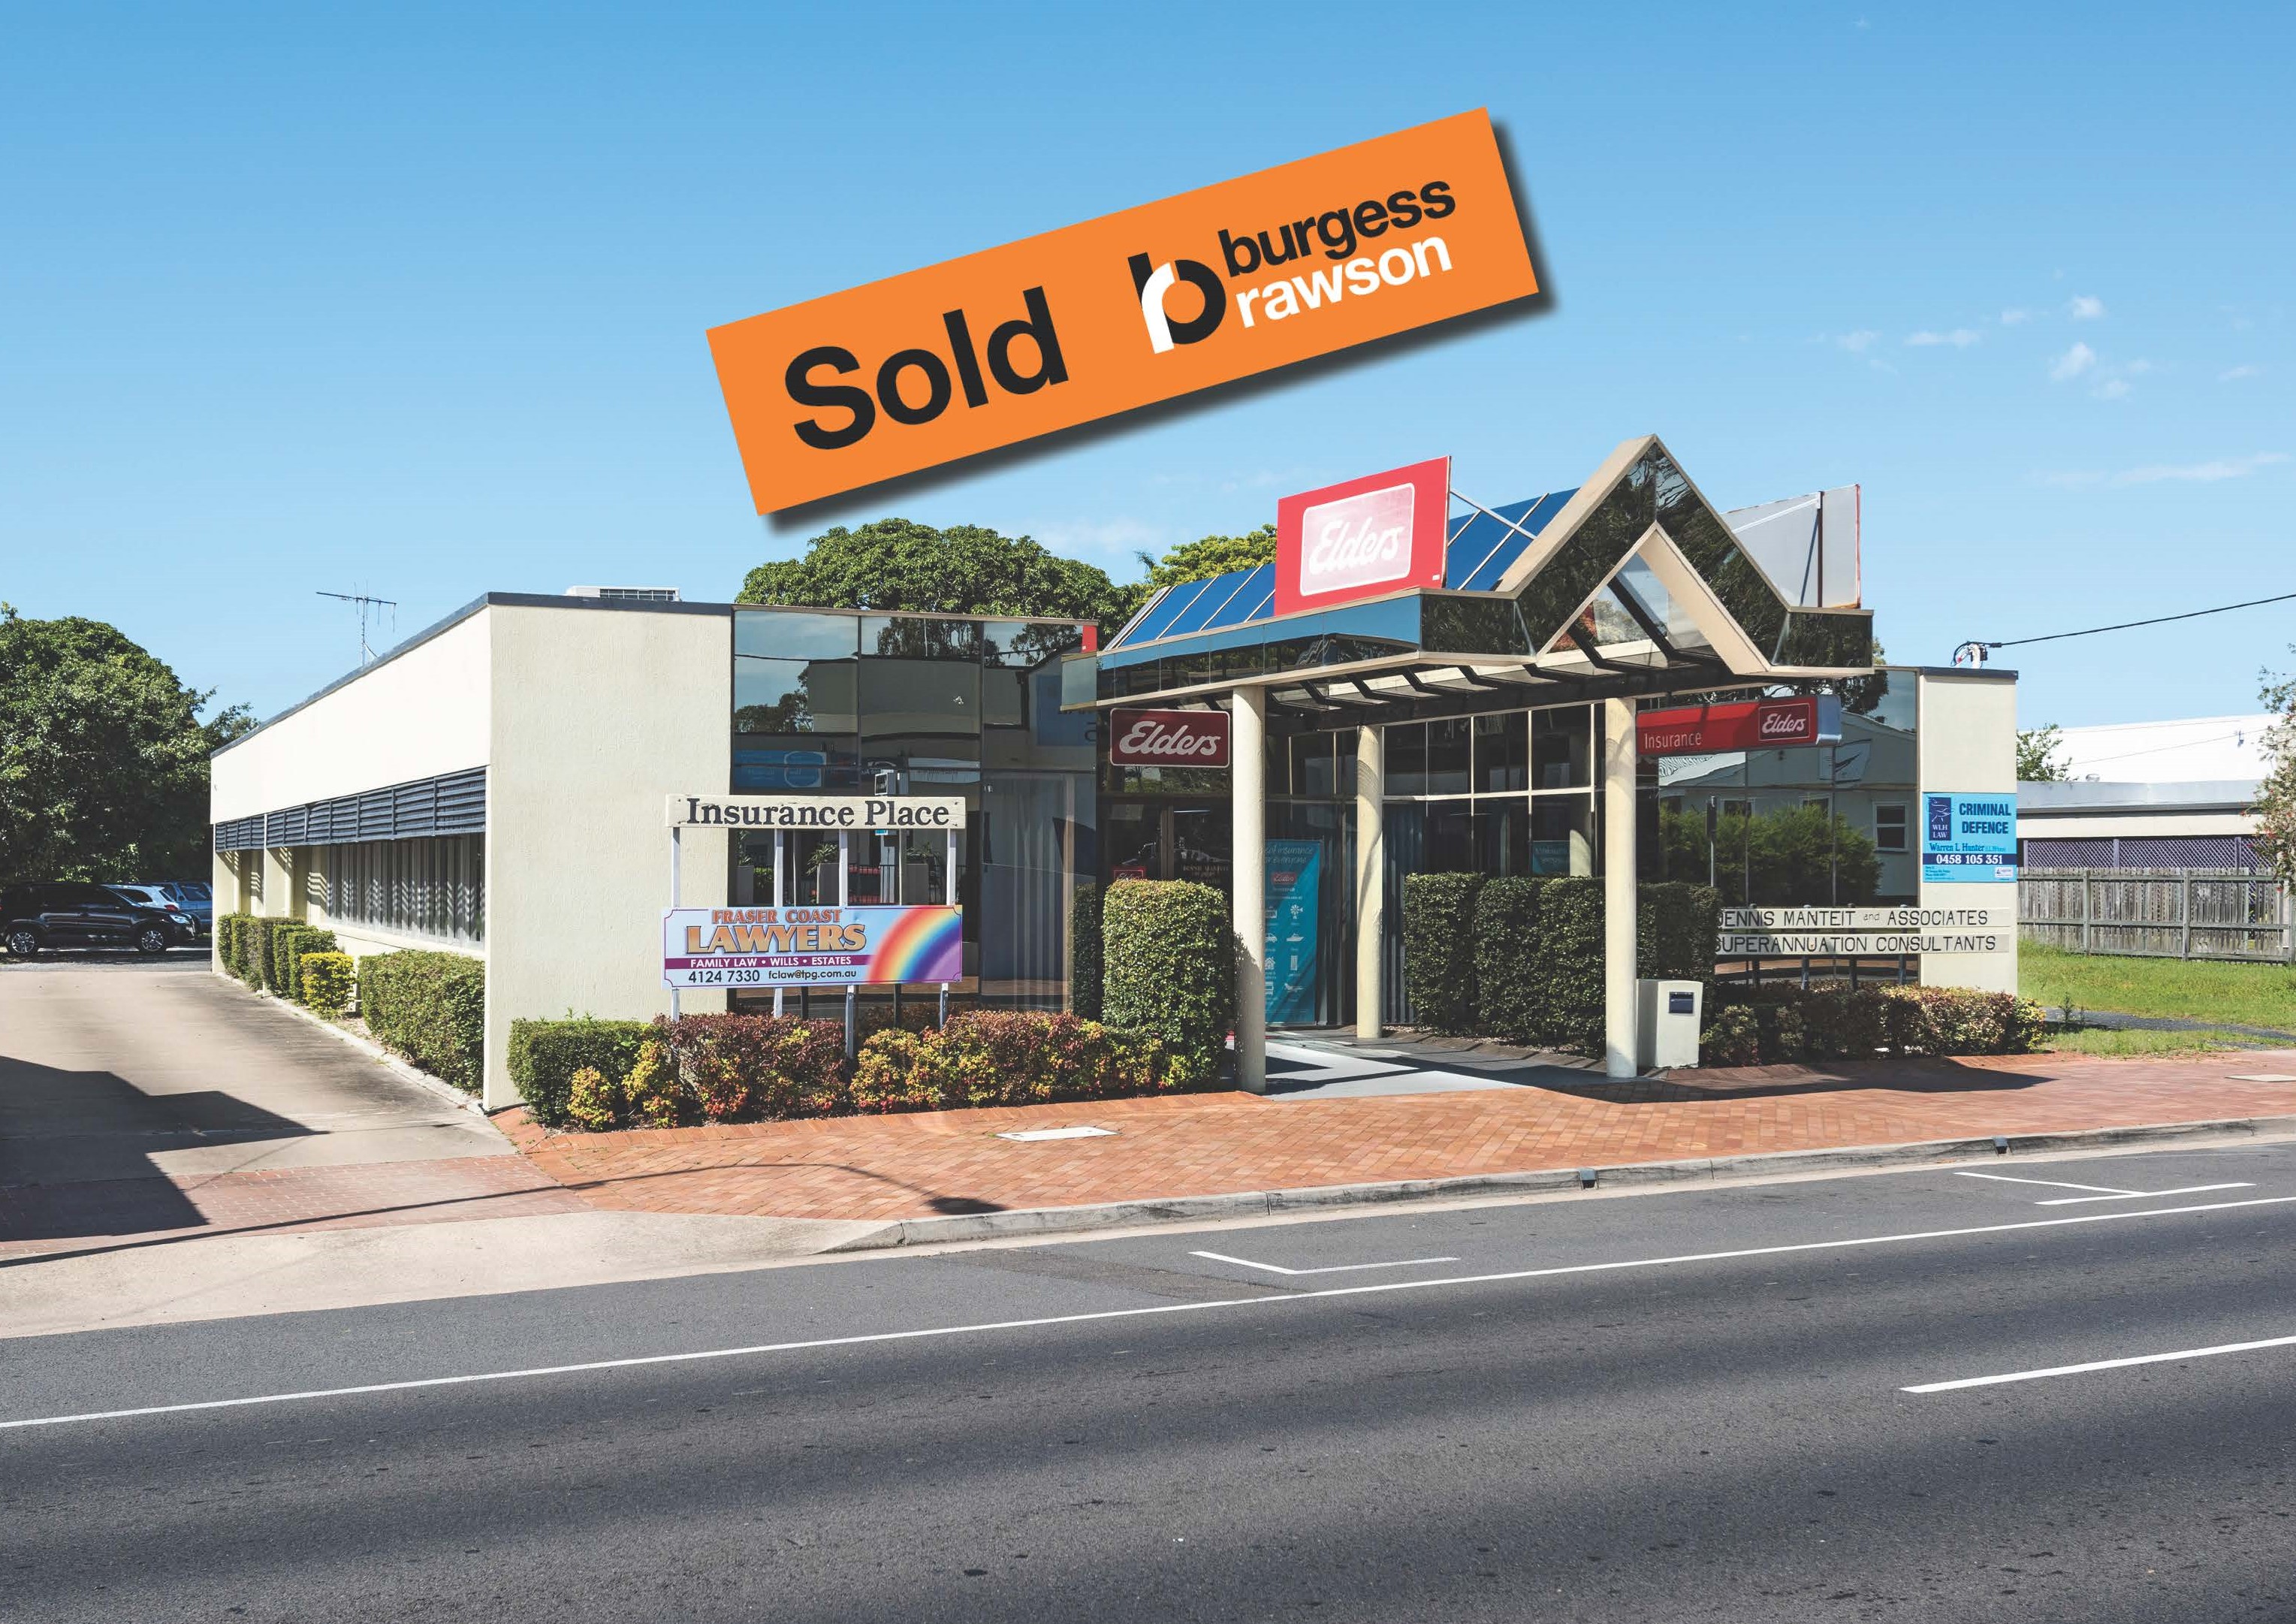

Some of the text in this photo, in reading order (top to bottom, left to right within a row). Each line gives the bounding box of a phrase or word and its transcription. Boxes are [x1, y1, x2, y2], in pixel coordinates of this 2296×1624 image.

[1308, 516, 1404, 575] Elders
[1761, 712, 1807, 735] Elders
[1119, 720, 1221, 756] Elders
[1644, 731, 1703, 750] Insurance
[686, 798, 949, 827] Insurance Place
[1959, 803, 2012, 817] CRIMINAL
[1962, 821, 2009, 834] DEFENCE
[1936, 854, 2003, 865] 0458 105 351
[712, 908, 843, 924] FRASER COAST
[1784, 911, 1856, 926] MANTEIT
[1863, 912, 1880, 921] and
[1887, 910, 1988, 926] ASSOCIATES
[686, 924, 867, 955] LAWYERS
[1715, 935, 1996, 952] SUPERANNUATION CONSULTANTS
[690, 956, 852, 968] FAMILY LAW WILLS ESTATES
[688, 970, 857, 983] 4124 7330 fclaw@tpg.com.au
